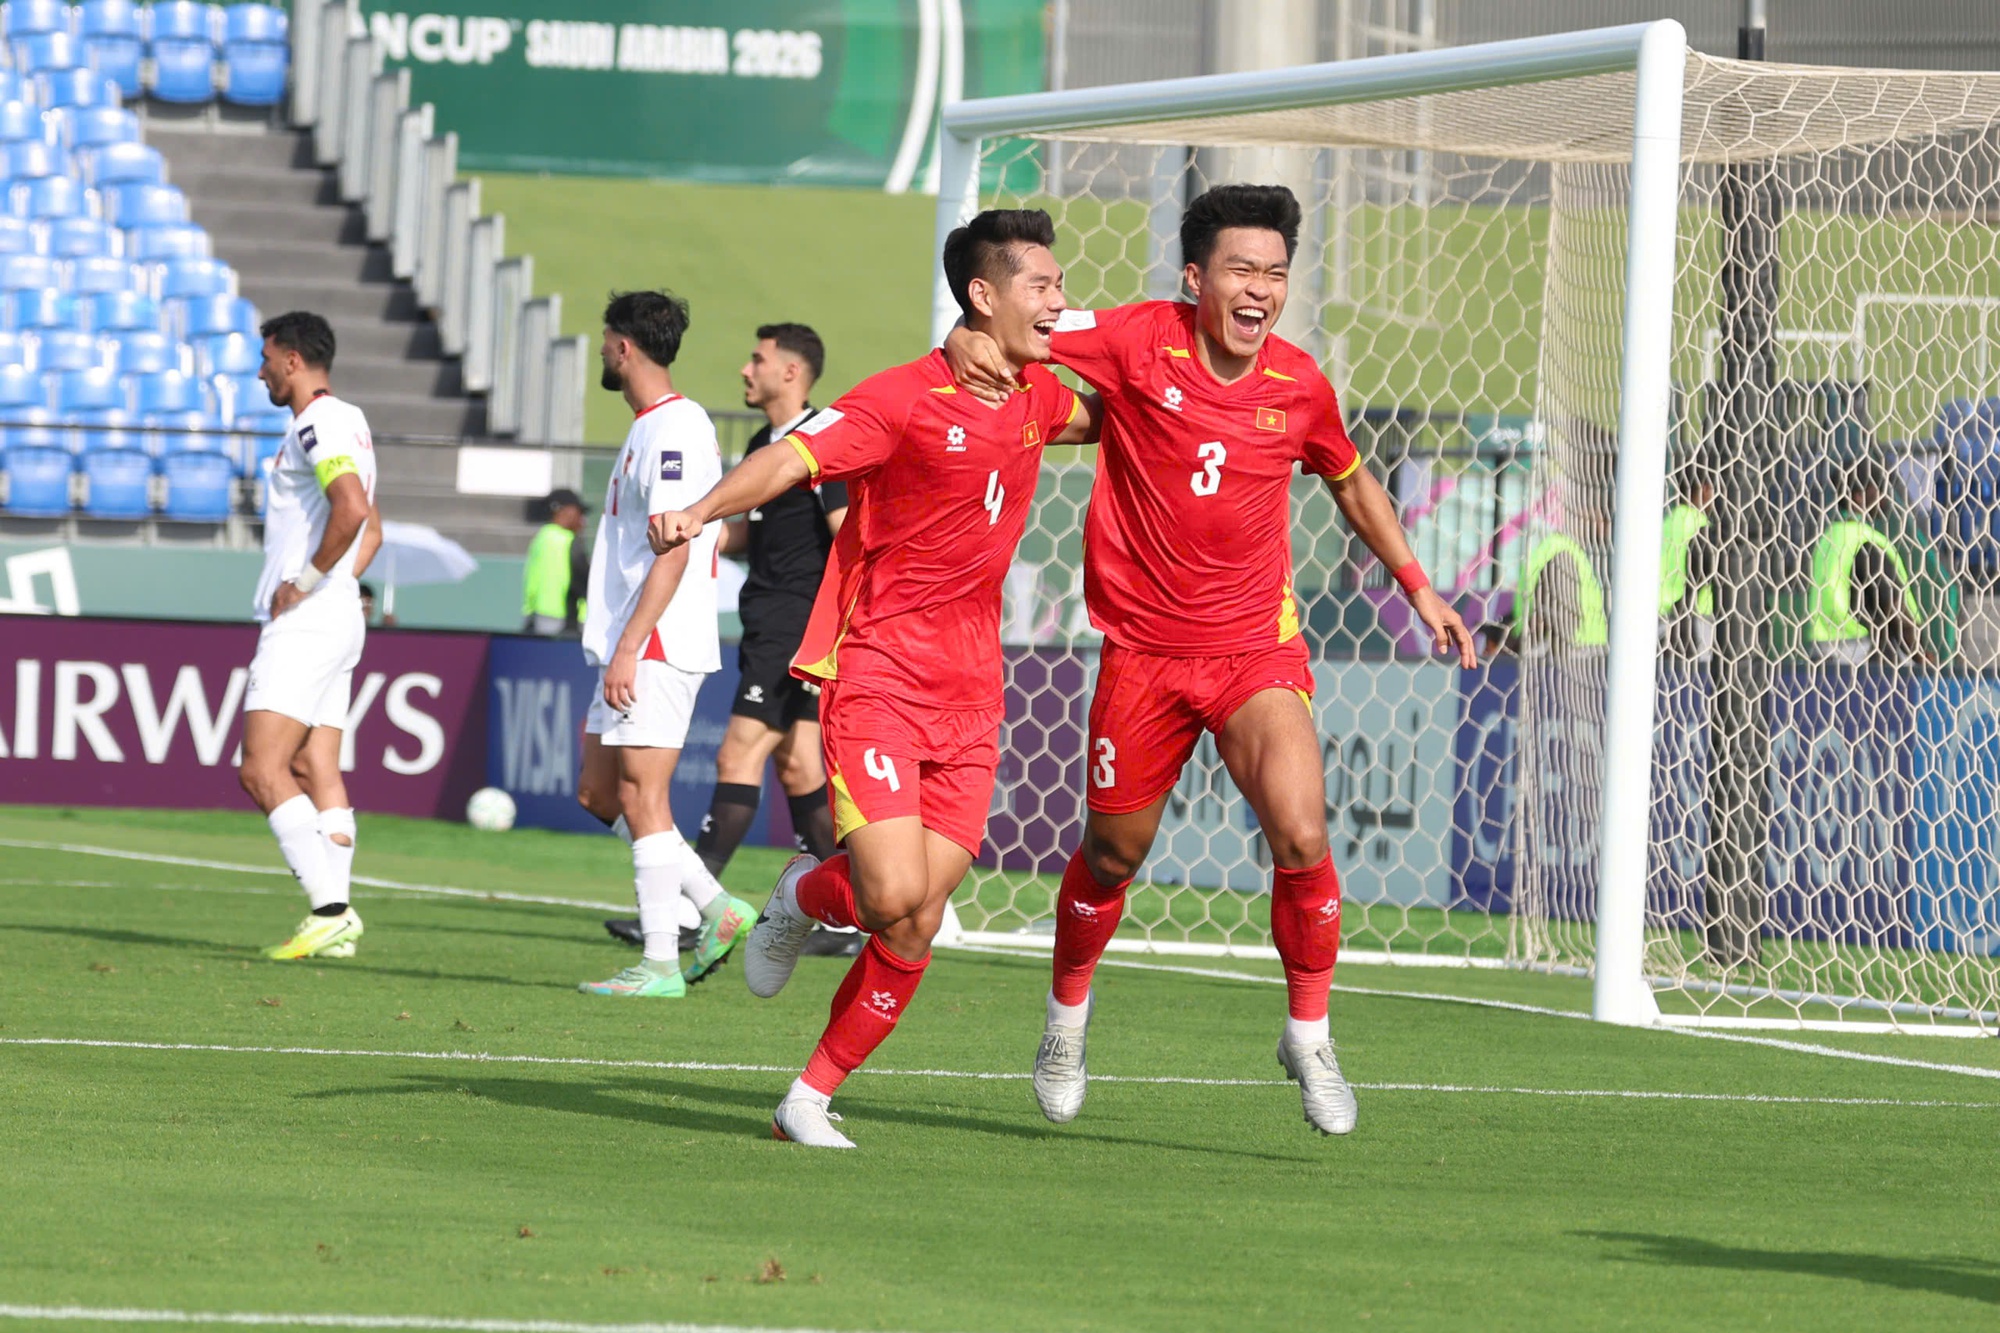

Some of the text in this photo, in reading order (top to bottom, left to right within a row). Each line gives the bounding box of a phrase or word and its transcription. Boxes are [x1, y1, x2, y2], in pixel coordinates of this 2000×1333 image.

[525, 19, 615, 70] SAUDI
[617, 23, 729, 74] ARABIA
[732, 28, 822, 79] 2026
[1190, 441, 1227, 496] 3
[984, 469, 1005, 526] 4
[0, 659, 446, 775] IRWYS
[495, 676, 572, 797] VISA
[864, 747, 901, 793] 4
[1093, 737, 1116, 789] 3
